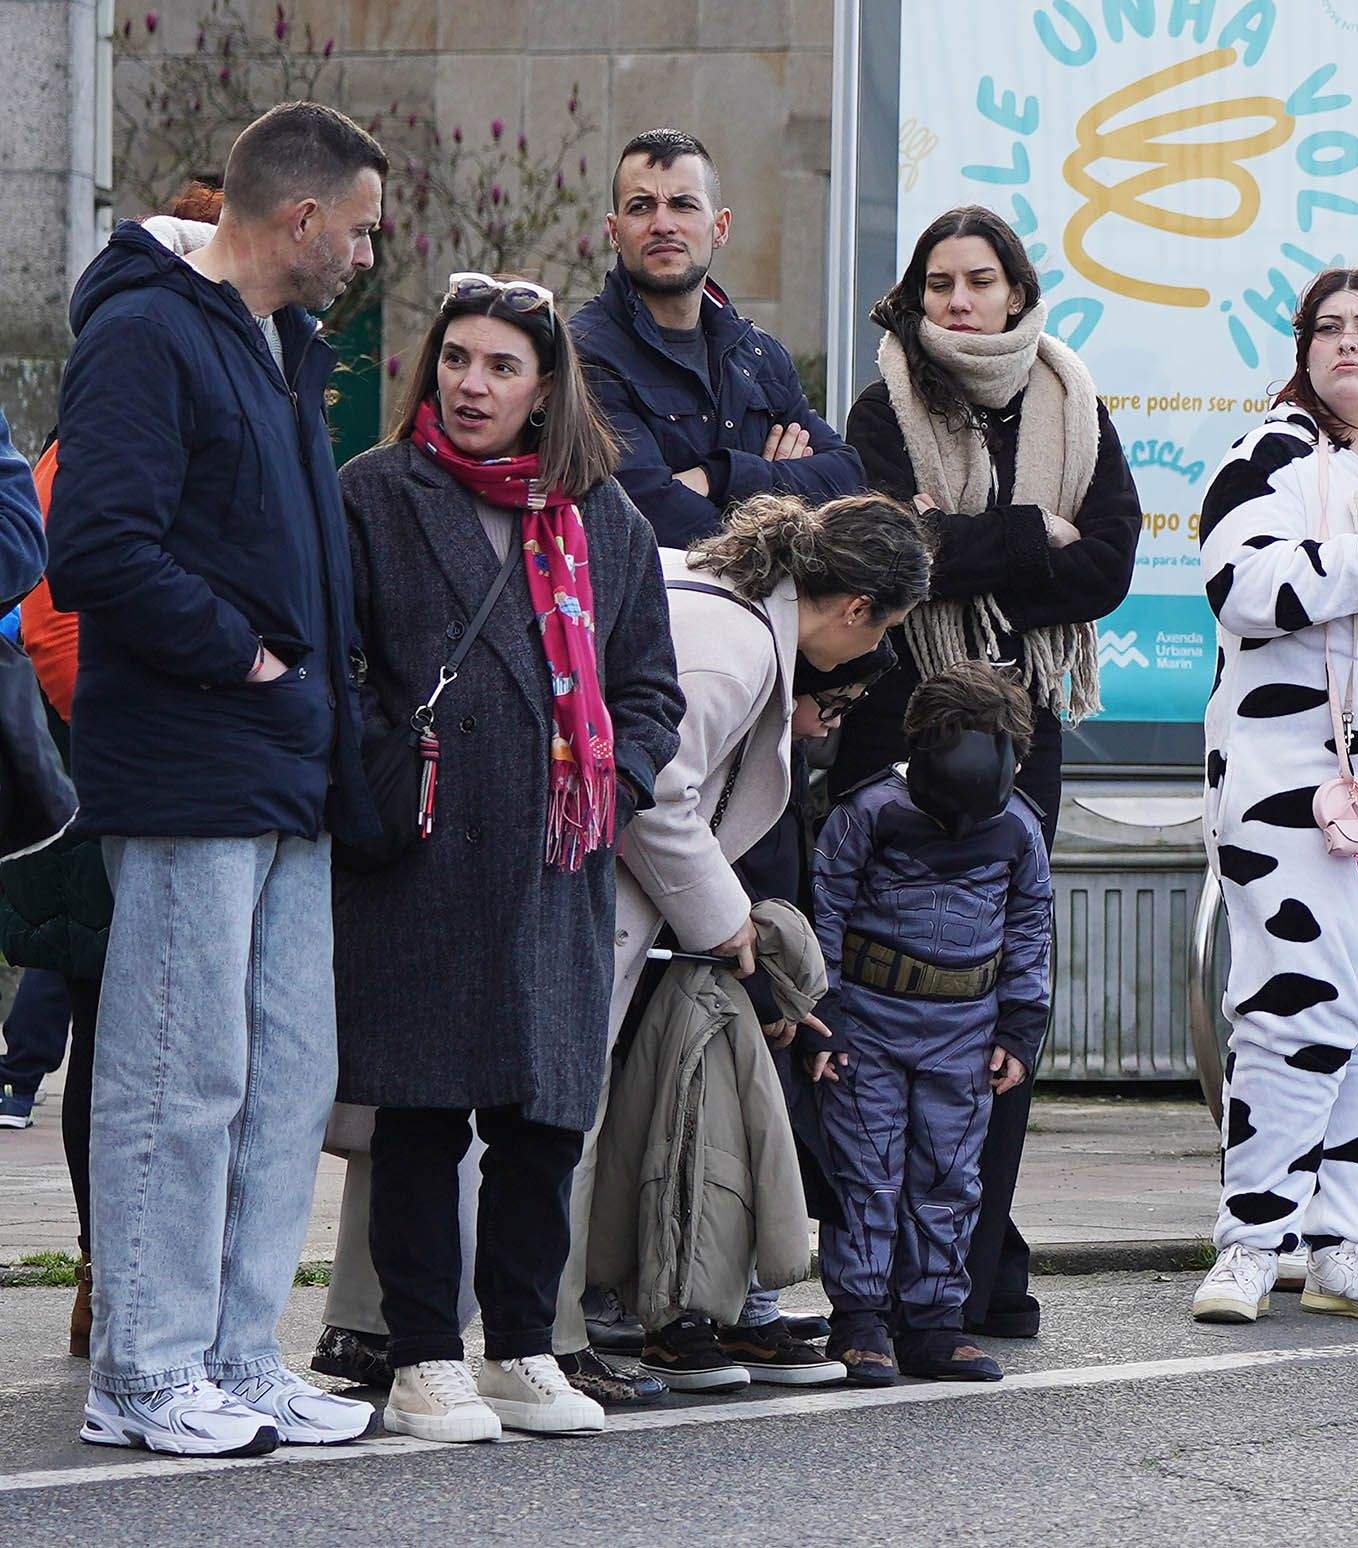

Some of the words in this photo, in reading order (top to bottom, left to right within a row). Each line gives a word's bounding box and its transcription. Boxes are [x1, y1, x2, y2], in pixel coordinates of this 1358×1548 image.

[1033, 0, 1277, 67] UNHA
[1147, 392, 1202, 416] poden
[1208, 396, 1237, 413] ser
[1156, 631, 1203, 644] Axenda
[1155, 644, 1203, 657] Urbana
